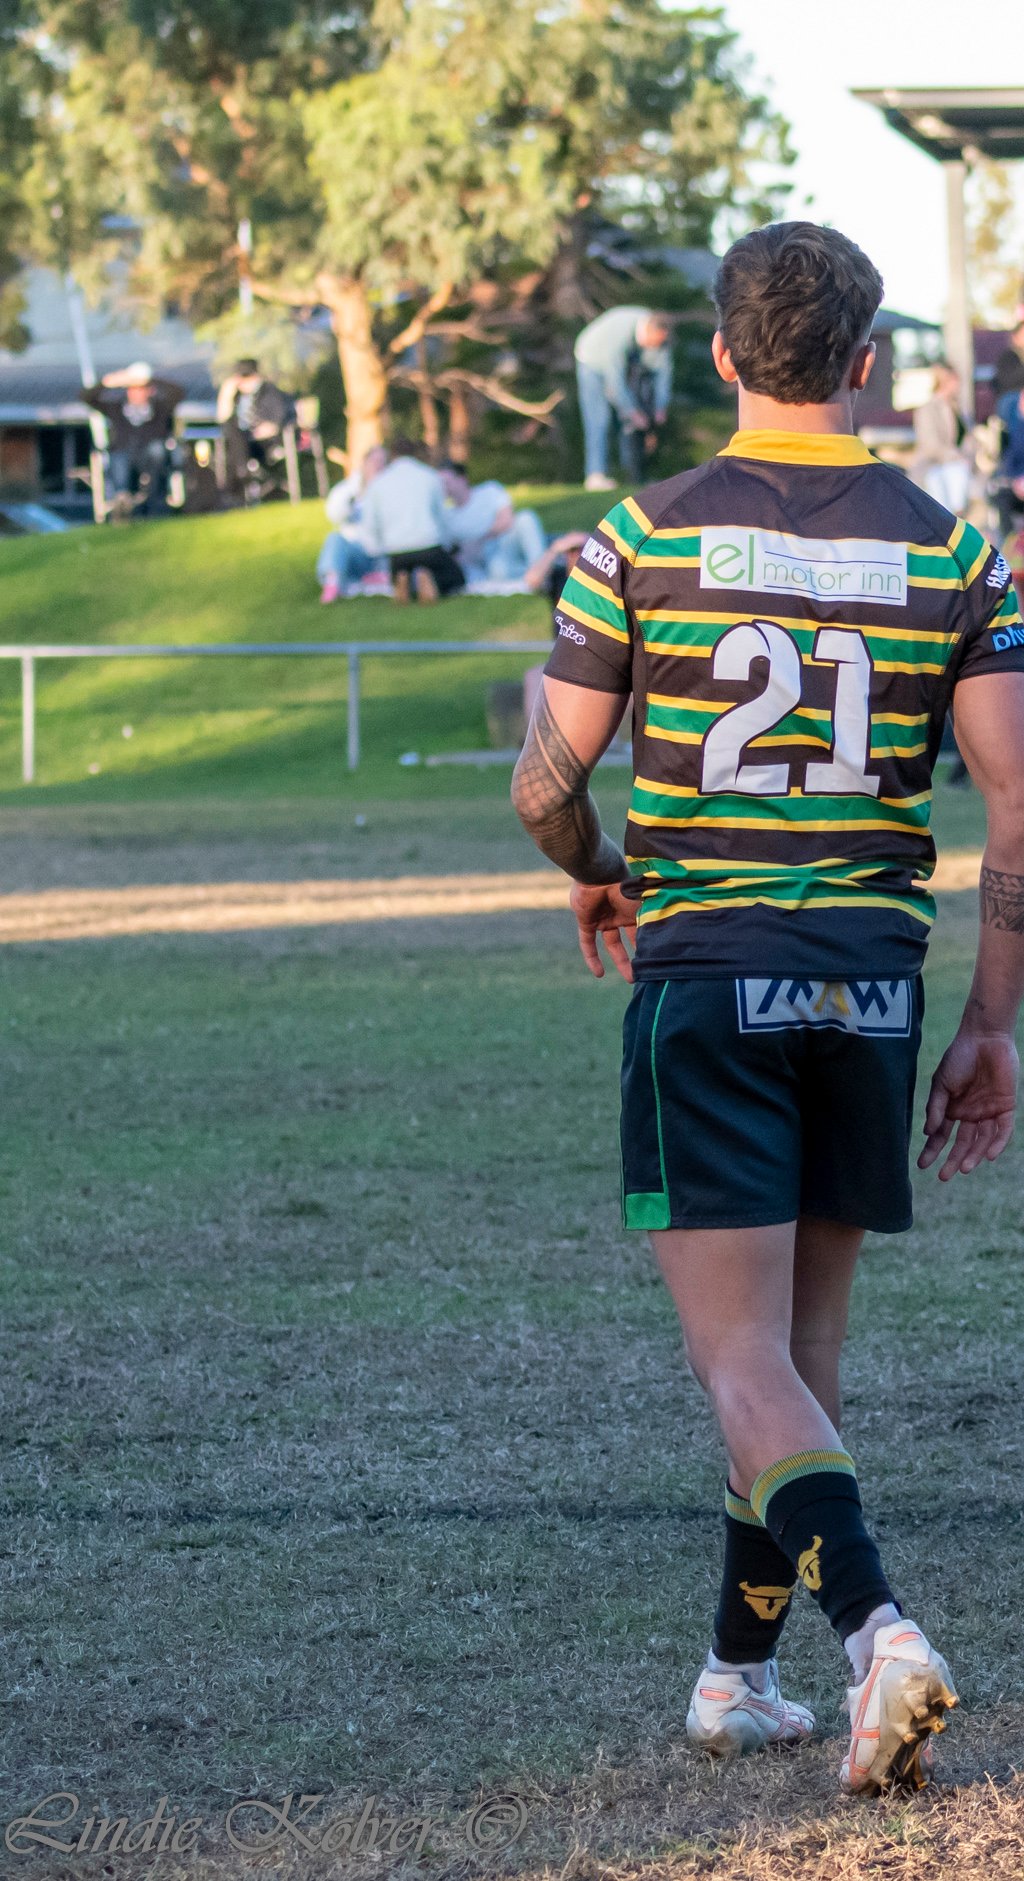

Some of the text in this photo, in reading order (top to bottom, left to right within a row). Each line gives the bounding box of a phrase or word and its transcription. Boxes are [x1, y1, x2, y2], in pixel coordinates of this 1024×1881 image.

[706, 534, 901, 593] el motor inn
[700, 620, 881, 797] 21
